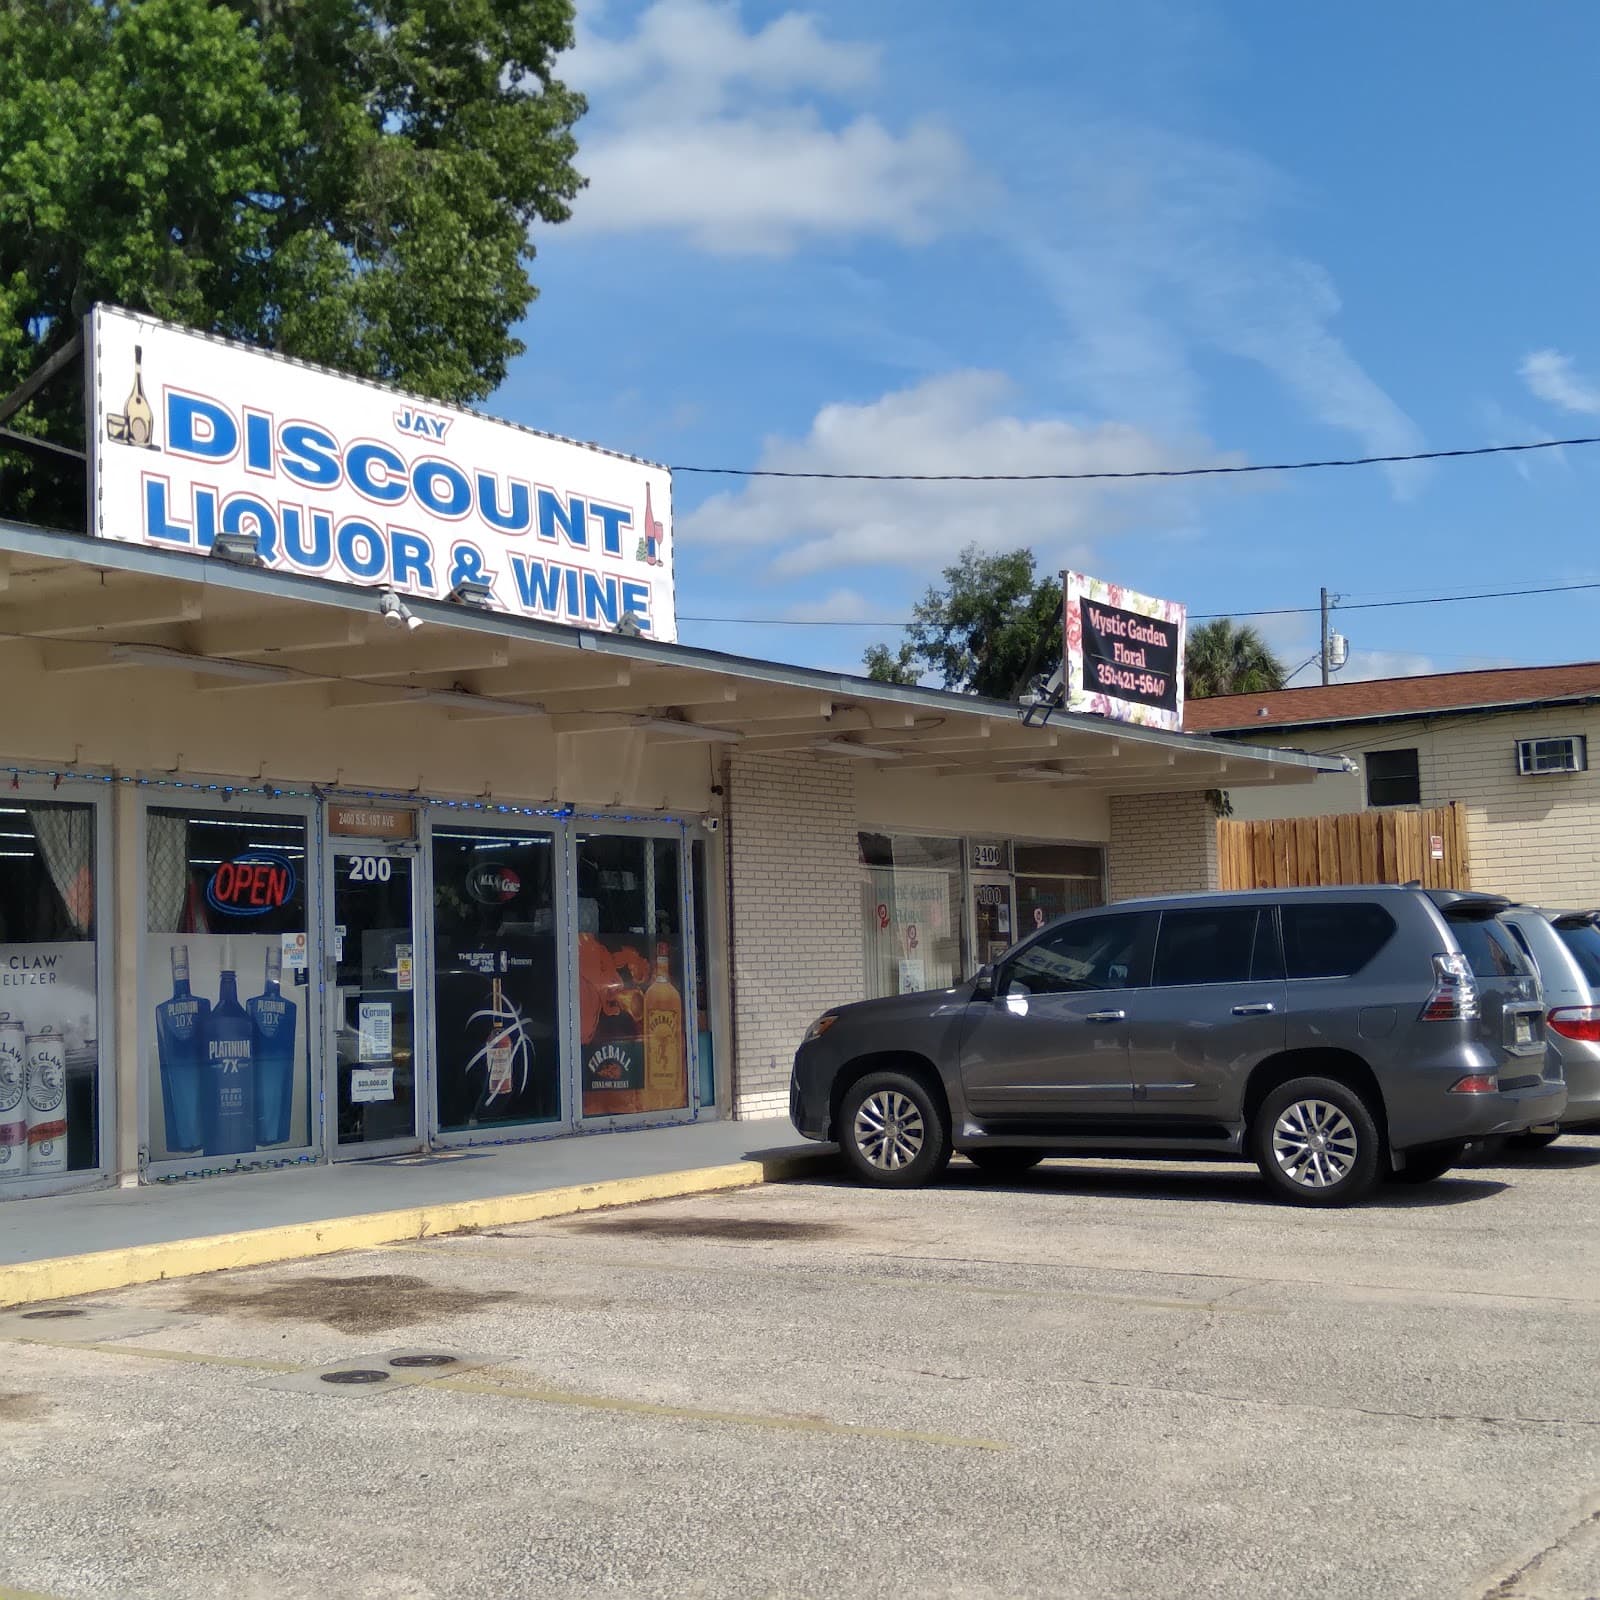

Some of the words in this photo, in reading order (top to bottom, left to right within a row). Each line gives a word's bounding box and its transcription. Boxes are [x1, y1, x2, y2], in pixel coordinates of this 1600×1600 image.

[394, 408, 450, 442] JAY
[164, 388, 632, 556] DISCOUNT
[143, 474, 436, 592] LIQUOR
[449, 542, 502, 606] &
[508, 553, 651, 632] WINE
[1089, 607, 1126, 636] Mystic
[1127, 619, 1168, 648] Garden
[1113, 642, 1146, 668] Floral
[1097, 663, 1165, 696] 352-421-5640
[338, 812, 354, 825] 2400
[975, 846, 1000, 863] 2400
[349, 856, 391, 882] 200
[214, 862, 287, 907] OPEN
[979, 886, 1001, 905] 100
[9, 955, 57, 970] CLAW
[3, 972, 56, 986] ELTZER
[361, 1007, 390, 1019] Corona
[0, 1042, 23, 1063] LAW
[209, 1040, 251, 1059] PLATINUM
[588, 1044, 631, 1073] FIREBALL
[222, 1060, 239, 1073] 7X
